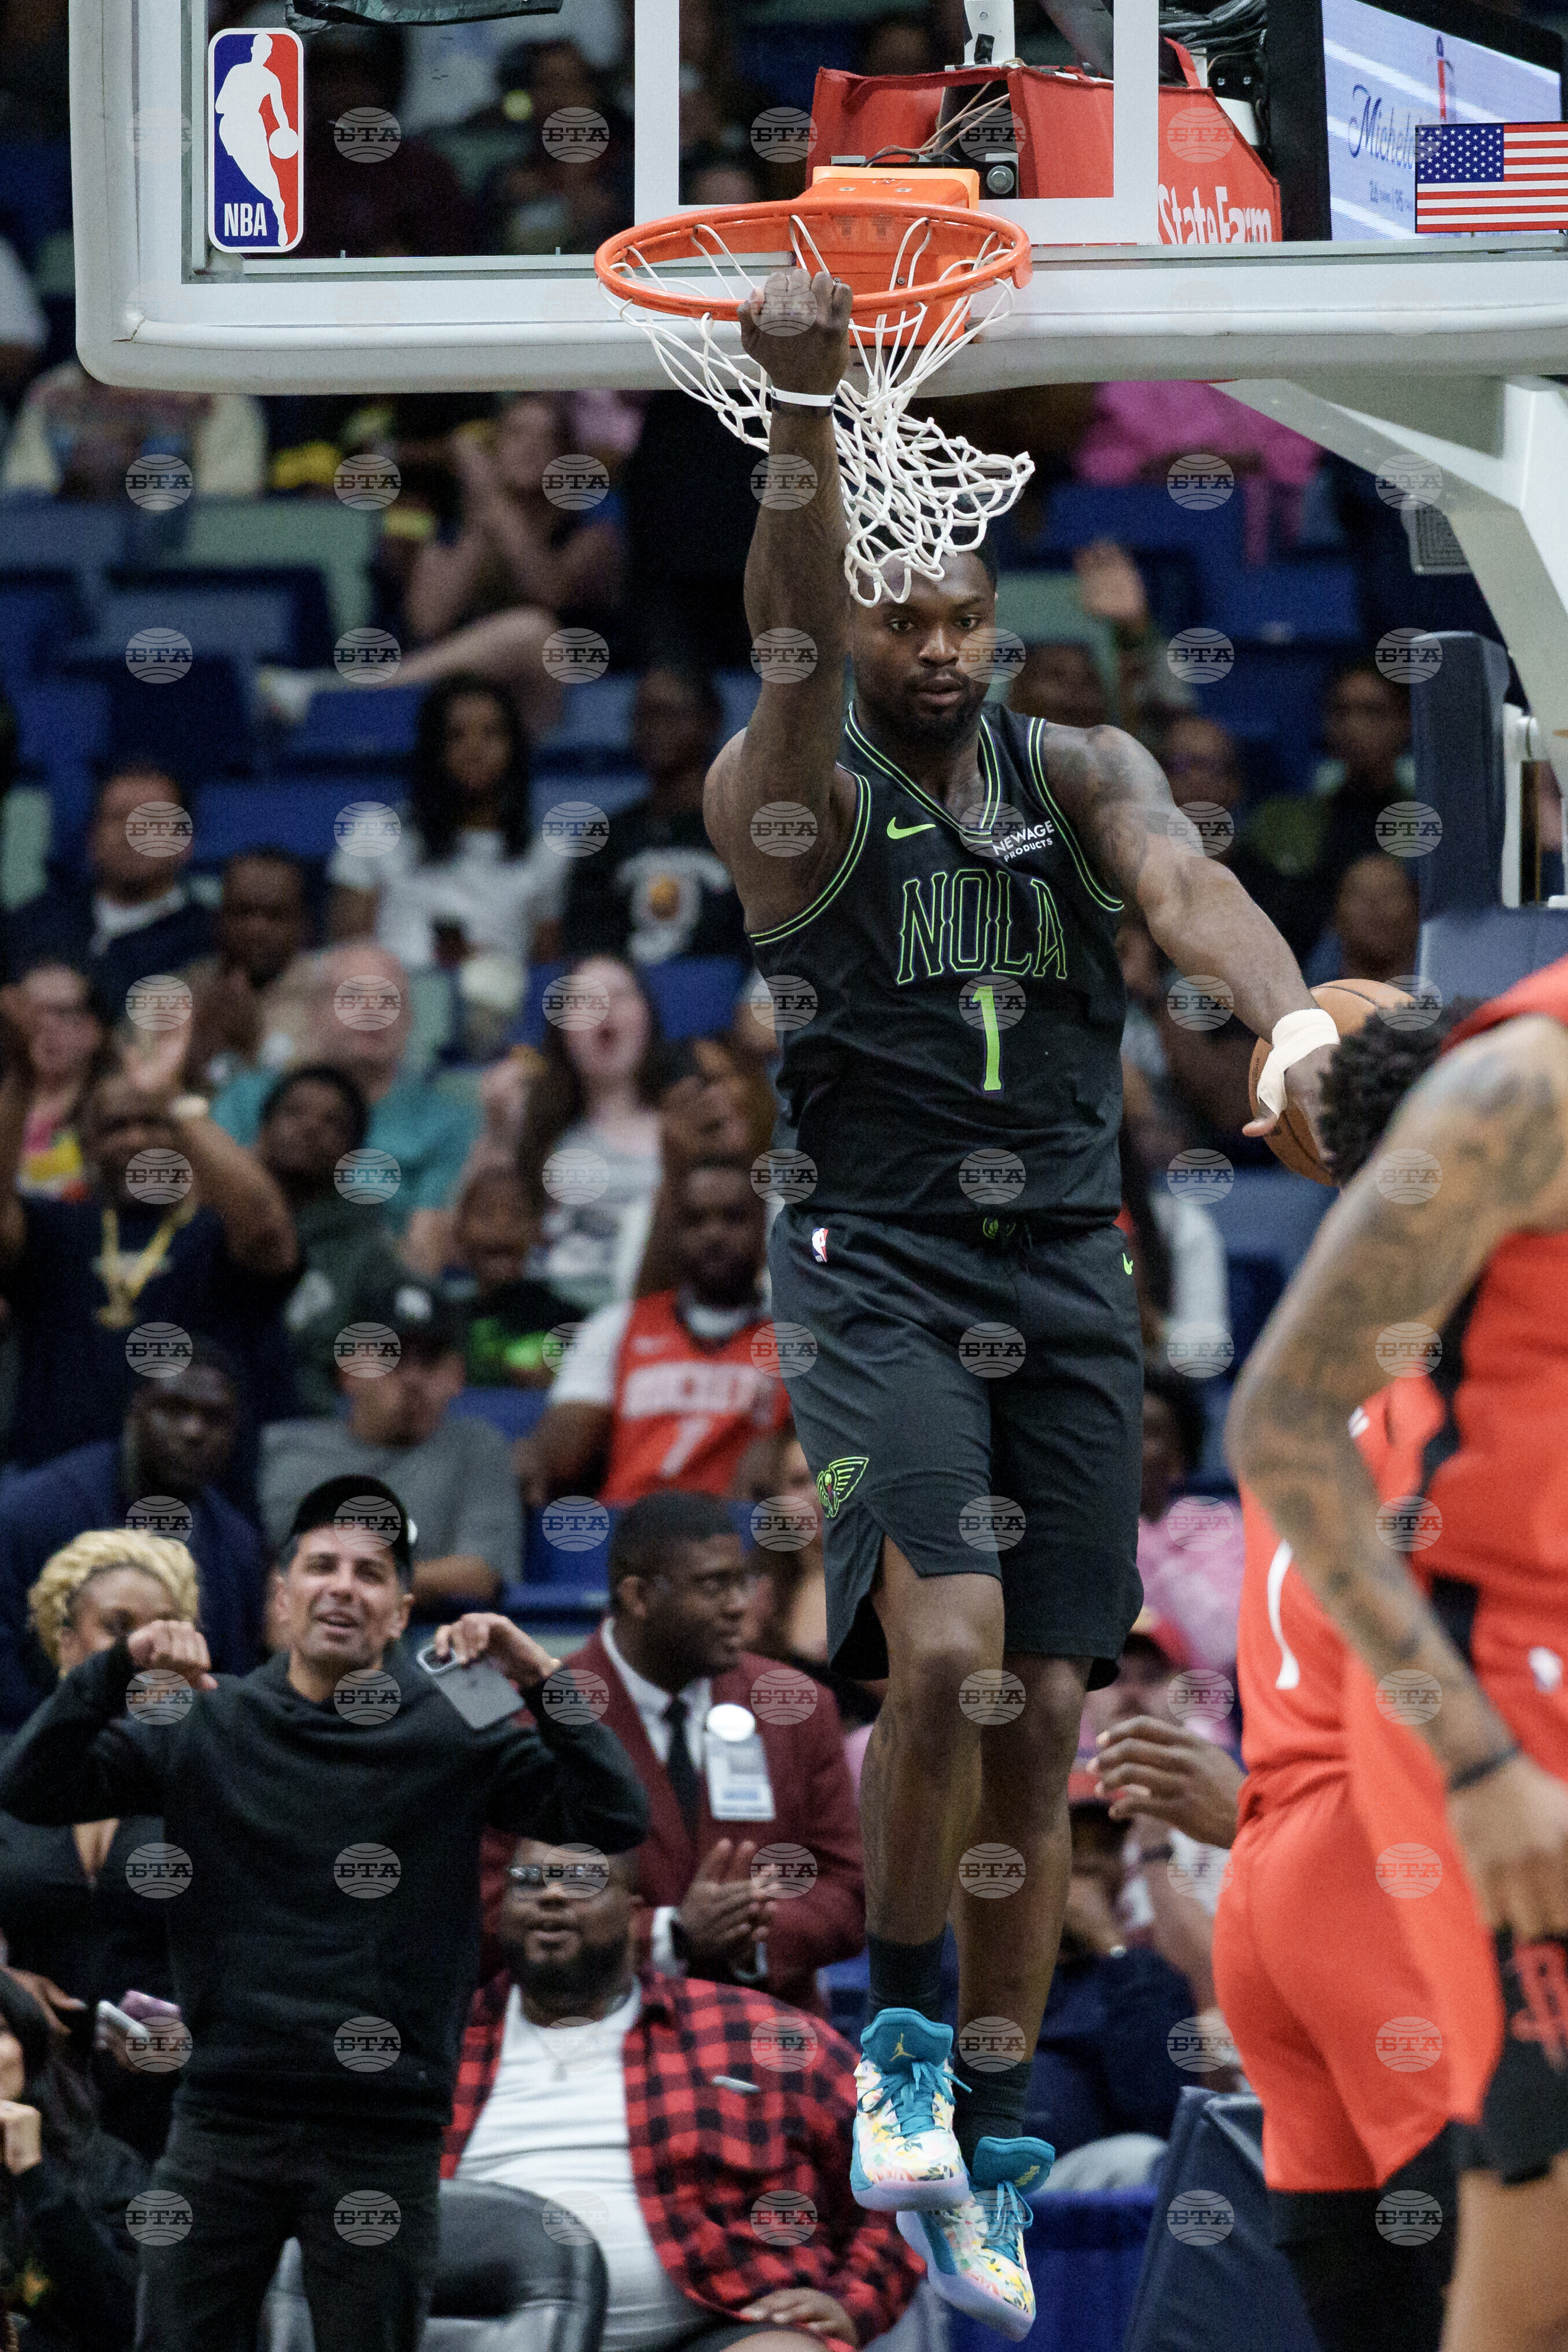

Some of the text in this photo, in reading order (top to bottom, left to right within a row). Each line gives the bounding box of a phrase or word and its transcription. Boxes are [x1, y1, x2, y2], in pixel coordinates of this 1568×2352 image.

[224, 203, 267, 236] NBA
[992, 820, 1055, 856] NEWAGE
[1004, 837, 1053, 862] PRODUCTS
[897, 869, 1067, 985] NOLA
[972, 985, 1002, 1091] 1
